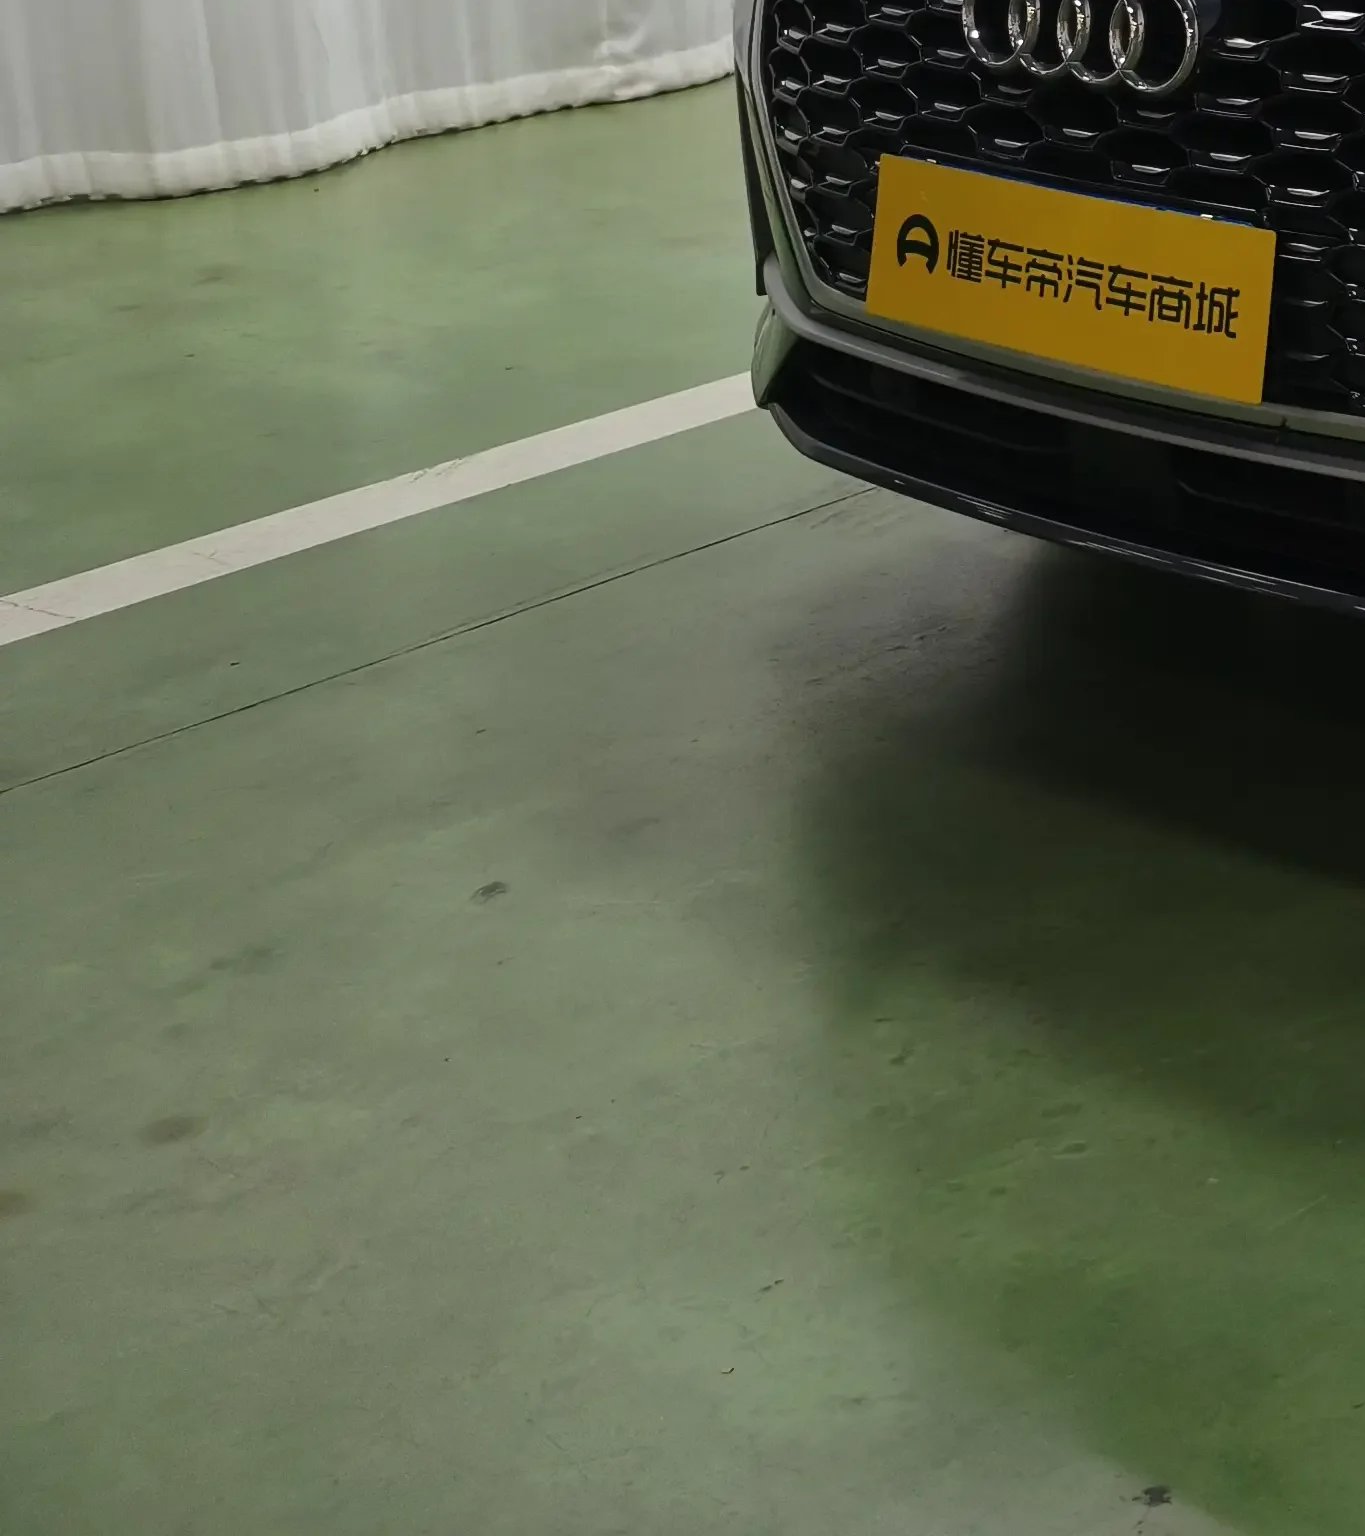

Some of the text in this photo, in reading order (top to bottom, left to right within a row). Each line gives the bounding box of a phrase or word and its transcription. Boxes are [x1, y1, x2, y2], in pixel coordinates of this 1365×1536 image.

[946, 229, 1240, 339] 懂车帝汽车商城
